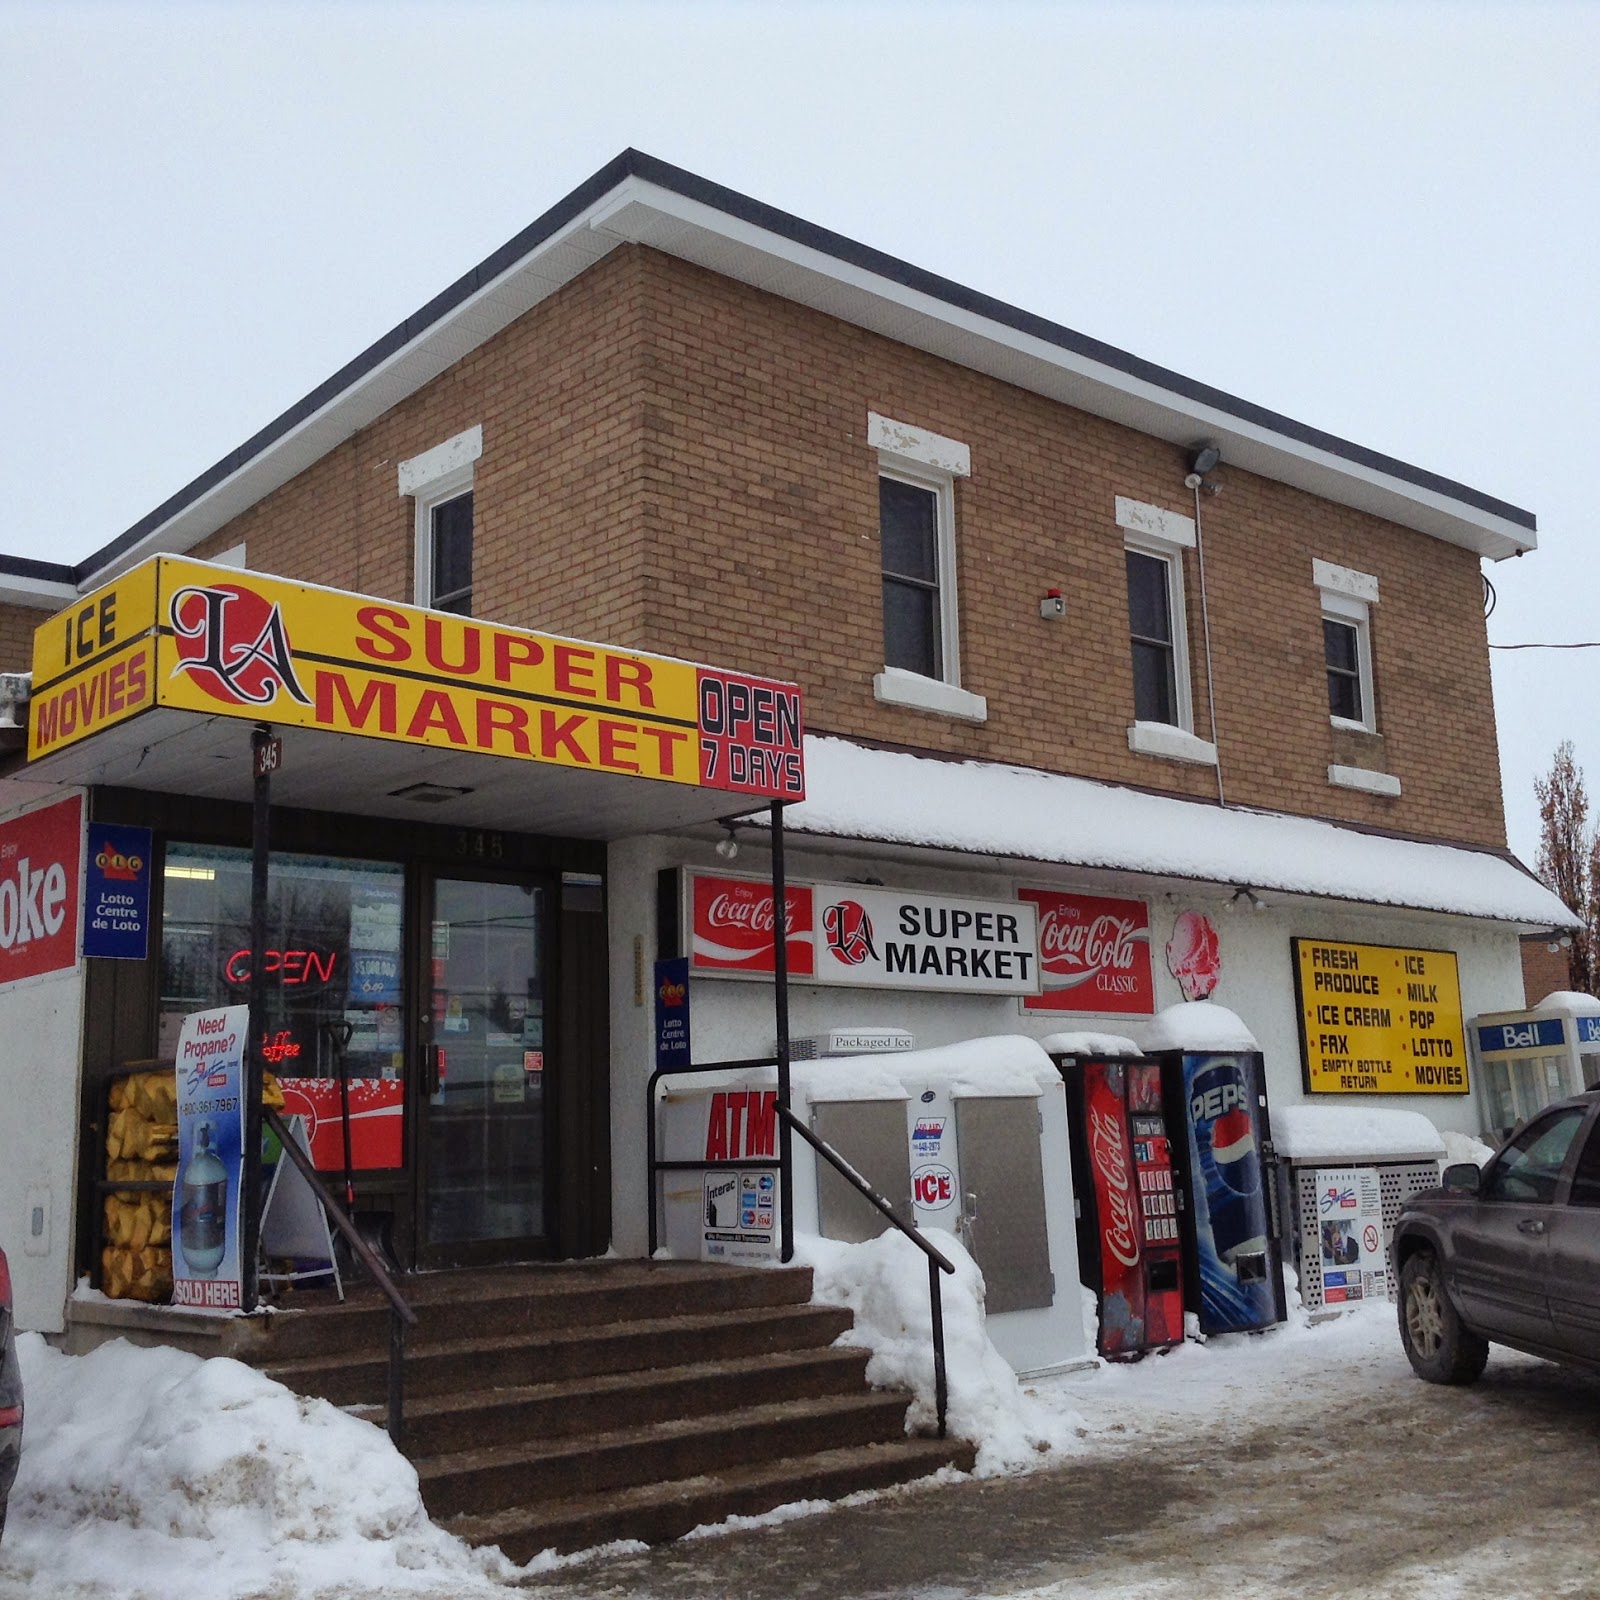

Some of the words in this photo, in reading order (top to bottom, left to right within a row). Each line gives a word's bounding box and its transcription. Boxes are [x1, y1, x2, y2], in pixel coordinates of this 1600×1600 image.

[64, 592, 117, 667] ICE
[170, 585, 314, 706] LA
[355, 606, 656, 708] SUPER
[36, 651, 147, 750] MOVIES
[315, 670, 688, 777] MARKET
[700, 677, 800, 749] OPEN
[260, 742, 277, 772] 345
[701, 740, 718, 780] 7
[730, 745, 802, 793] DAYS
[97, 854, 141, 870] OLG
[0, 857, 67, 949] oke
[100, 892, 134, 905] Lotto
[735, 887, 754, 899] Enjoy
[96, 904, 138, 918] Centre
[708, 893, 797, 932] Coca-Coa
[1058, 903, 1080, 920] Enjoy
[92, 918, 108, 930] de
[112, 918, 141, 932] Loto
[899, 904, 1019, 944] SUPER
[885, 942, 1033, 981] MARKET
[1312, 948, 1358, 970] FRESH
[1404, 956, 1424, 975] ICE
[1096, 973, 1138, 993] CLASSIC
[1314, 972, 1379, 995] PRODUCE
[1407, 983, 1438, 1004] MILK
[196, 1014, 226, 1036] Need
[663, 1019, 682, 1028] Lotto
[1317, 1005, 1340, 1026] ICE
[1344, 1007, 1392, 1028] CREAM
[1409, 1010, 1434, 1030] POP
[660, 1042, 669, 1051] de
[671, 1041, 686, 1050] Loto
[662, 1030, 684, 1039] Centre
[835, 1036, 890, 1049] Packaged
[893, 1037, 911, 1048] Ice
[1319, 1034, 1349, 1054] FAX
[1502, 1024, 1540, 1048] Bell
[184, 1033, 236, 1060] Propane?
[262, 1031, 300, 1062] offee
[1412, 1038, 1453, 1058] LOTTO
[1322, 1059, 1353, 1073] EMPTY
[1357, 1060, 1392, 1074] BOTTLE
[1415, 1066, 1462, 1085] MOVIES
[1341, 1076, 1378, 1088] RETURN
[706, 1091, 777, 1160] ATM
[706, 1180, 736, 1207] Interac
[914, 1173, 951, 1204] ICE
[1090, 1104, 1139, 1267] Coca-Cola
[175, 1280, 202, 1304] SOLD
[205, 1282, 238, 1306] HERE
